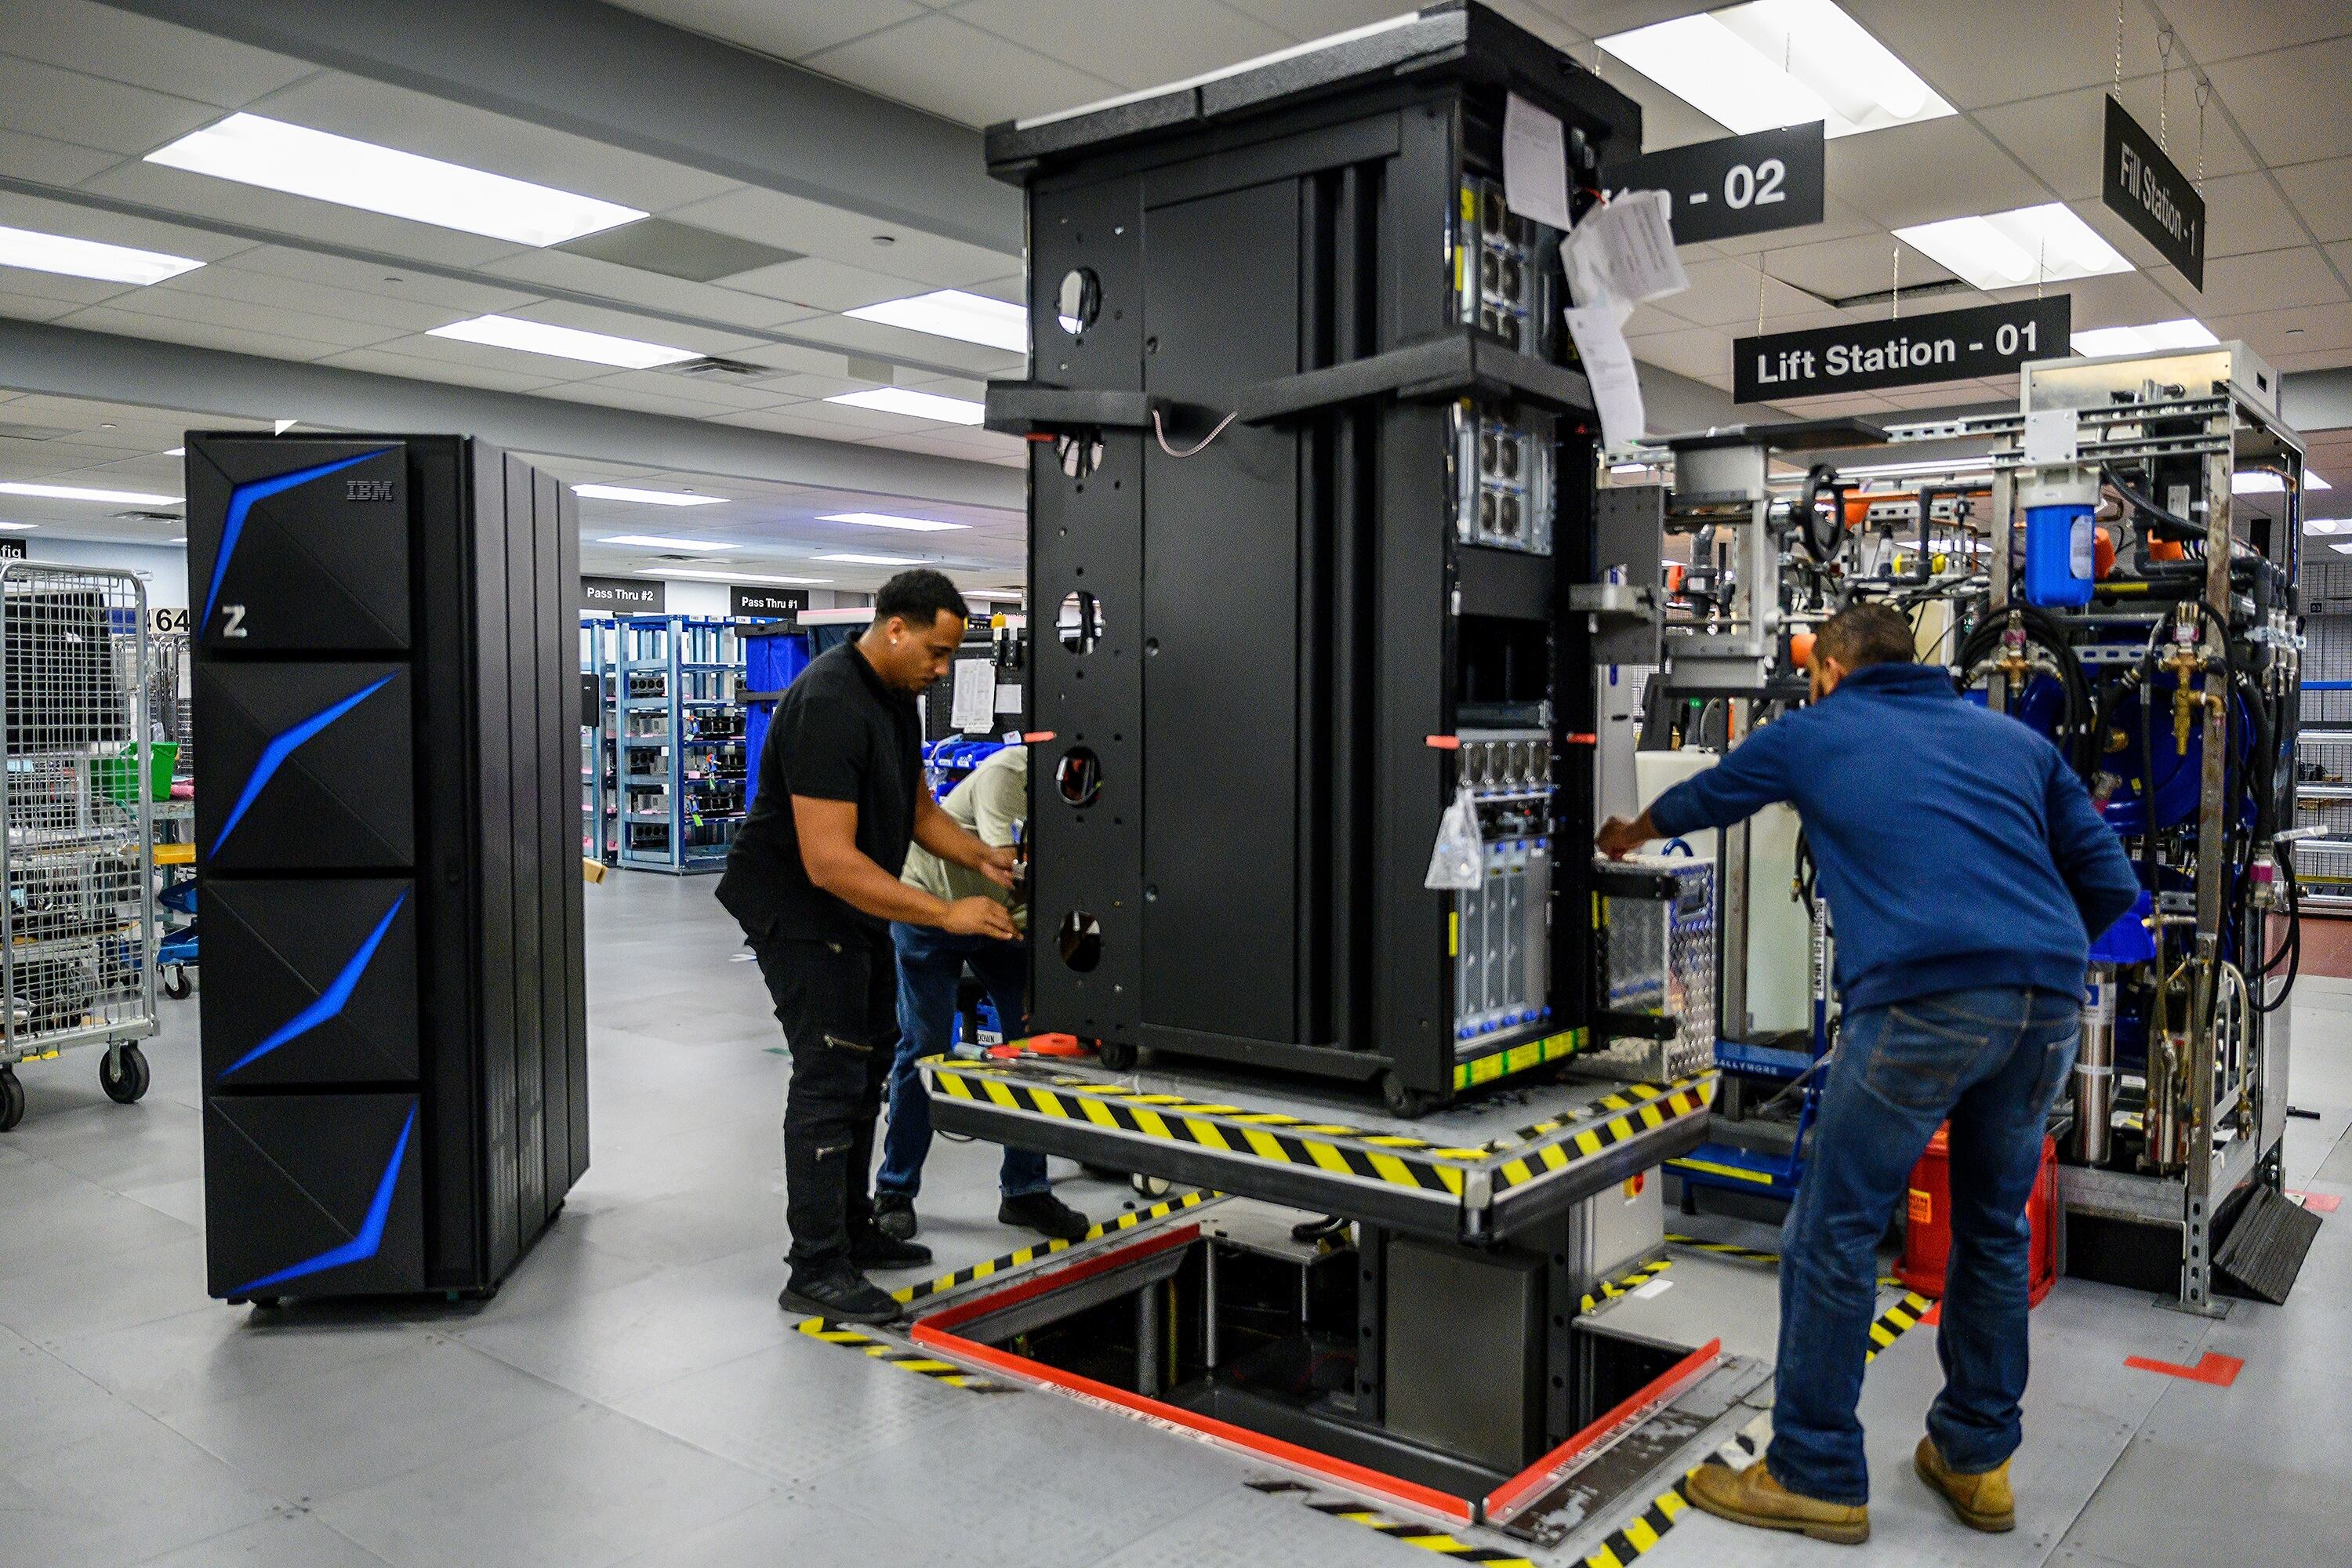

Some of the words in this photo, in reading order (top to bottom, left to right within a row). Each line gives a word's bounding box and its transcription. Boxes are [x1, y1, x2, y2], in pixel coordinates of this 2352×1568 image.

[1689, 192, 1708, 205] -
[1724, 158, 1786, 210] 02
[2120, 142, 2140, 200] Fill
[2143, 165, 2182, 242] Station
[2190, 219, 2195, 257] 1
[1757, 350, 1817, 384] Lift
[1824, 337, 1956, 376] Station
[1969, 343, 1984, 352] -
[1994, 320, 2038, 356] 01
[347, 481, 393, 501] IBM
[587, 587, 613, 599] Pass
[615, 589, 640, 601] Thru
[641, 590, 654, 601] #2
[742, 596, 764, 608] Pass
[765, 597, 786, 609] Thru
[788, 599, 798, 610] #1
